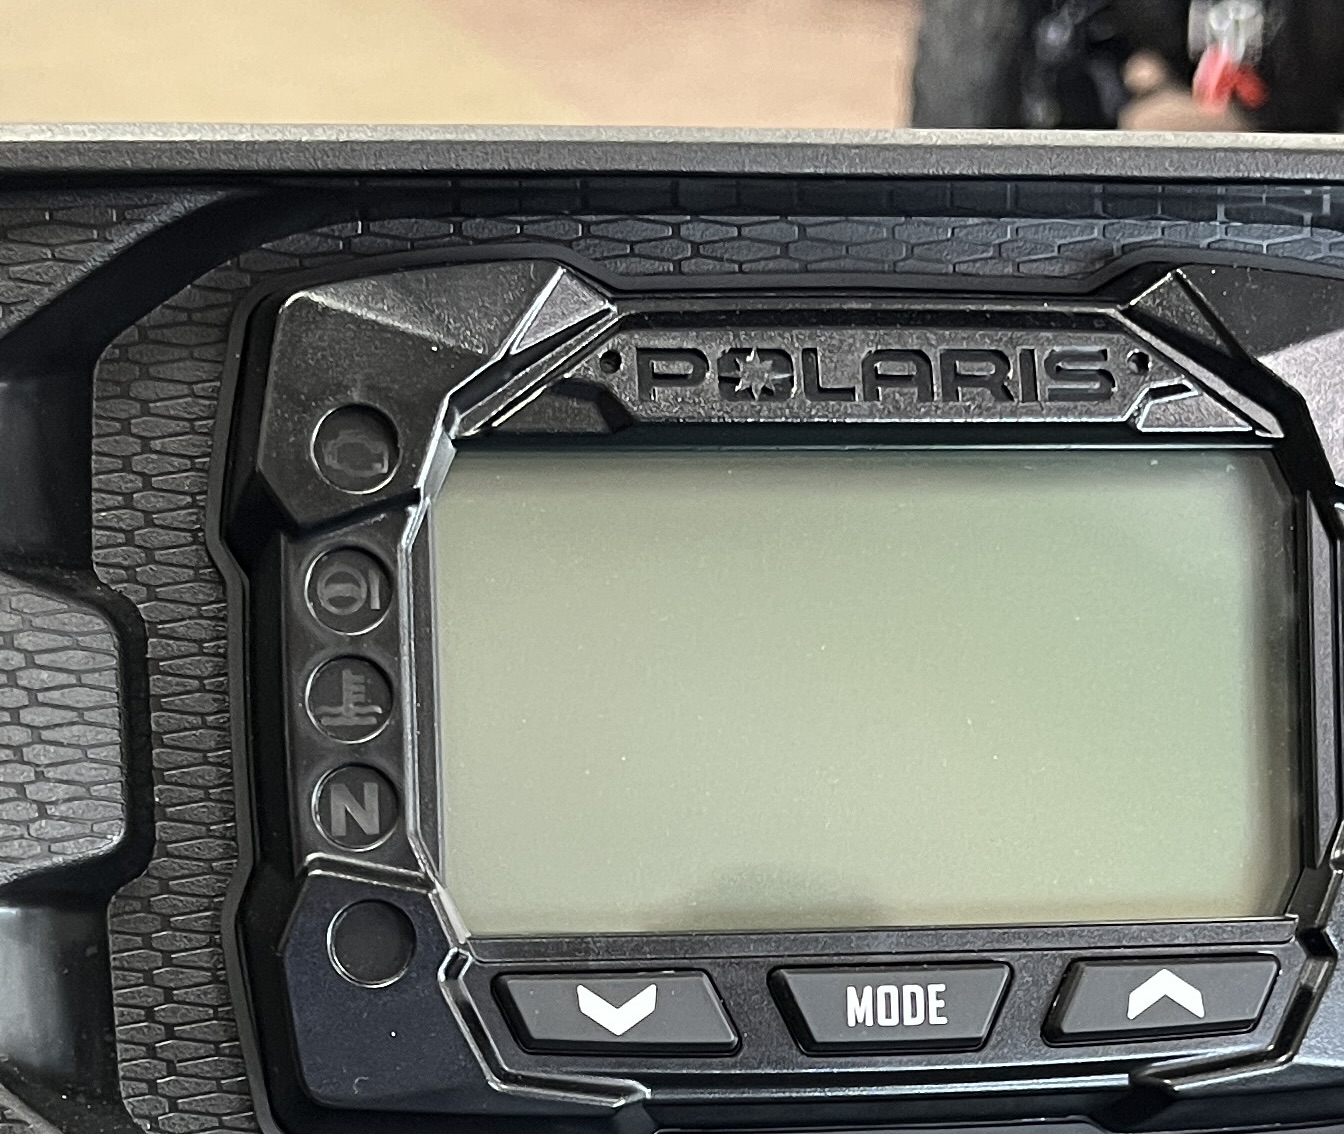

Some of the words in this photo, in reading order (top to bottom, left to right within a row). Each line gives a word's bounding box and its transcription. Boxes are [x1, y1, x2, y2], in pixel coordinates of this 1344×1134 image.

[637, 345, 1115, 402] POLARIS
[330, 782, 378, 836] N
[846, 982, 947, 1028] MODE
